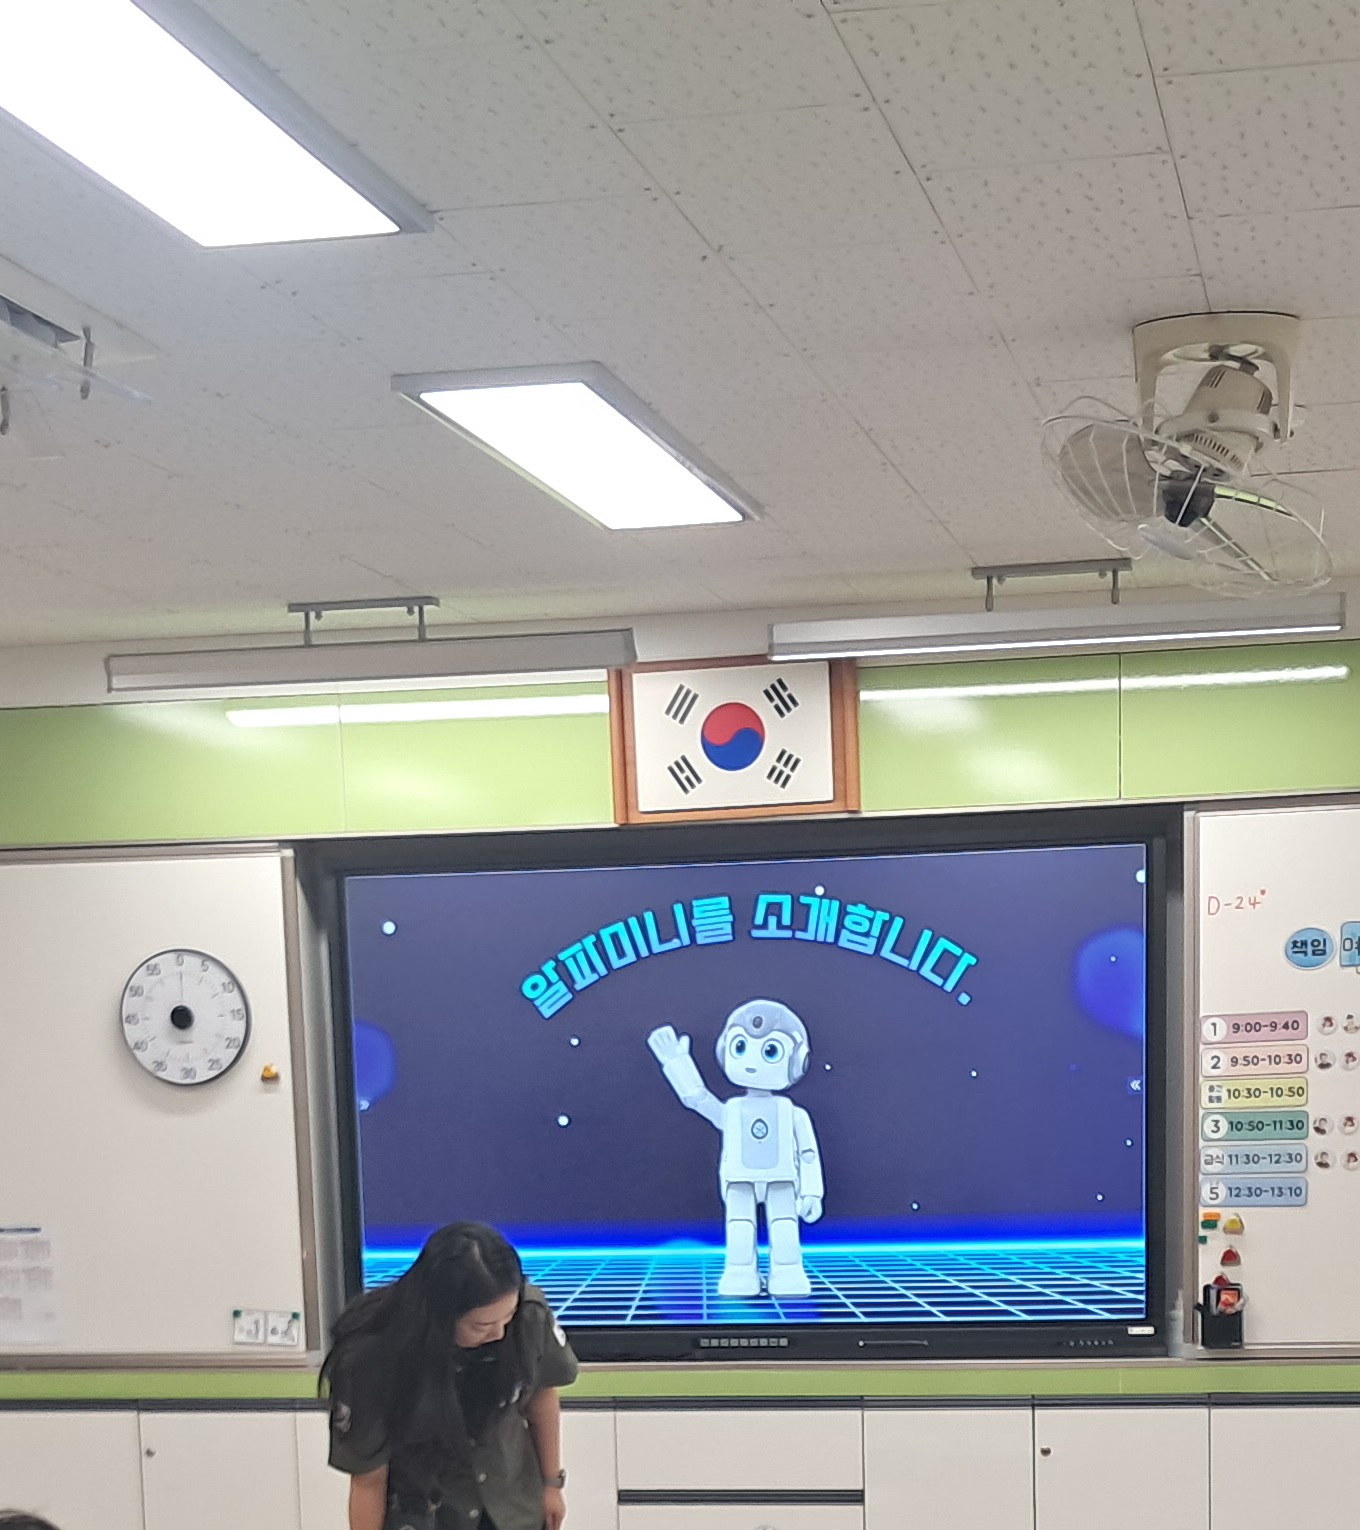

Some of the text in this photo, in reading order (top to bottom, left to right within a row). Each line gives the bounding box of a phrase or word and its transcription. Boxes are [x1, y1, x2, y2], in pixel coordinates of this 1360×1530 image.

[1291, 937, 1328, 957] 책임
[176, 954, 184, 967] 0
[519, 893, 979, 1020] 알파미니를 소개합니다.
[146, 963, 162, 976] 55
[201, 960, 210, 972] 5
[129, 985, 144, 998] 50
[221, 981, 236, 994] 10
[230, 1008, 245, 1021] 15
[1210, 1019, 1300, 1036] 1 9:00-9:40
[225, 1037, 240, 1050] 20
[207, 1058, 223, 1071] 25
[1210, 1053, 1303, 1070] 2 9:50-10:30
[180, 1066, 197, 1080] 30
[1226, 1086, 1305, 1100] 10:30-10:50
[1210, 1119, 1221, 1133] 3
[1208, 1187, 1219, 1201] 5
